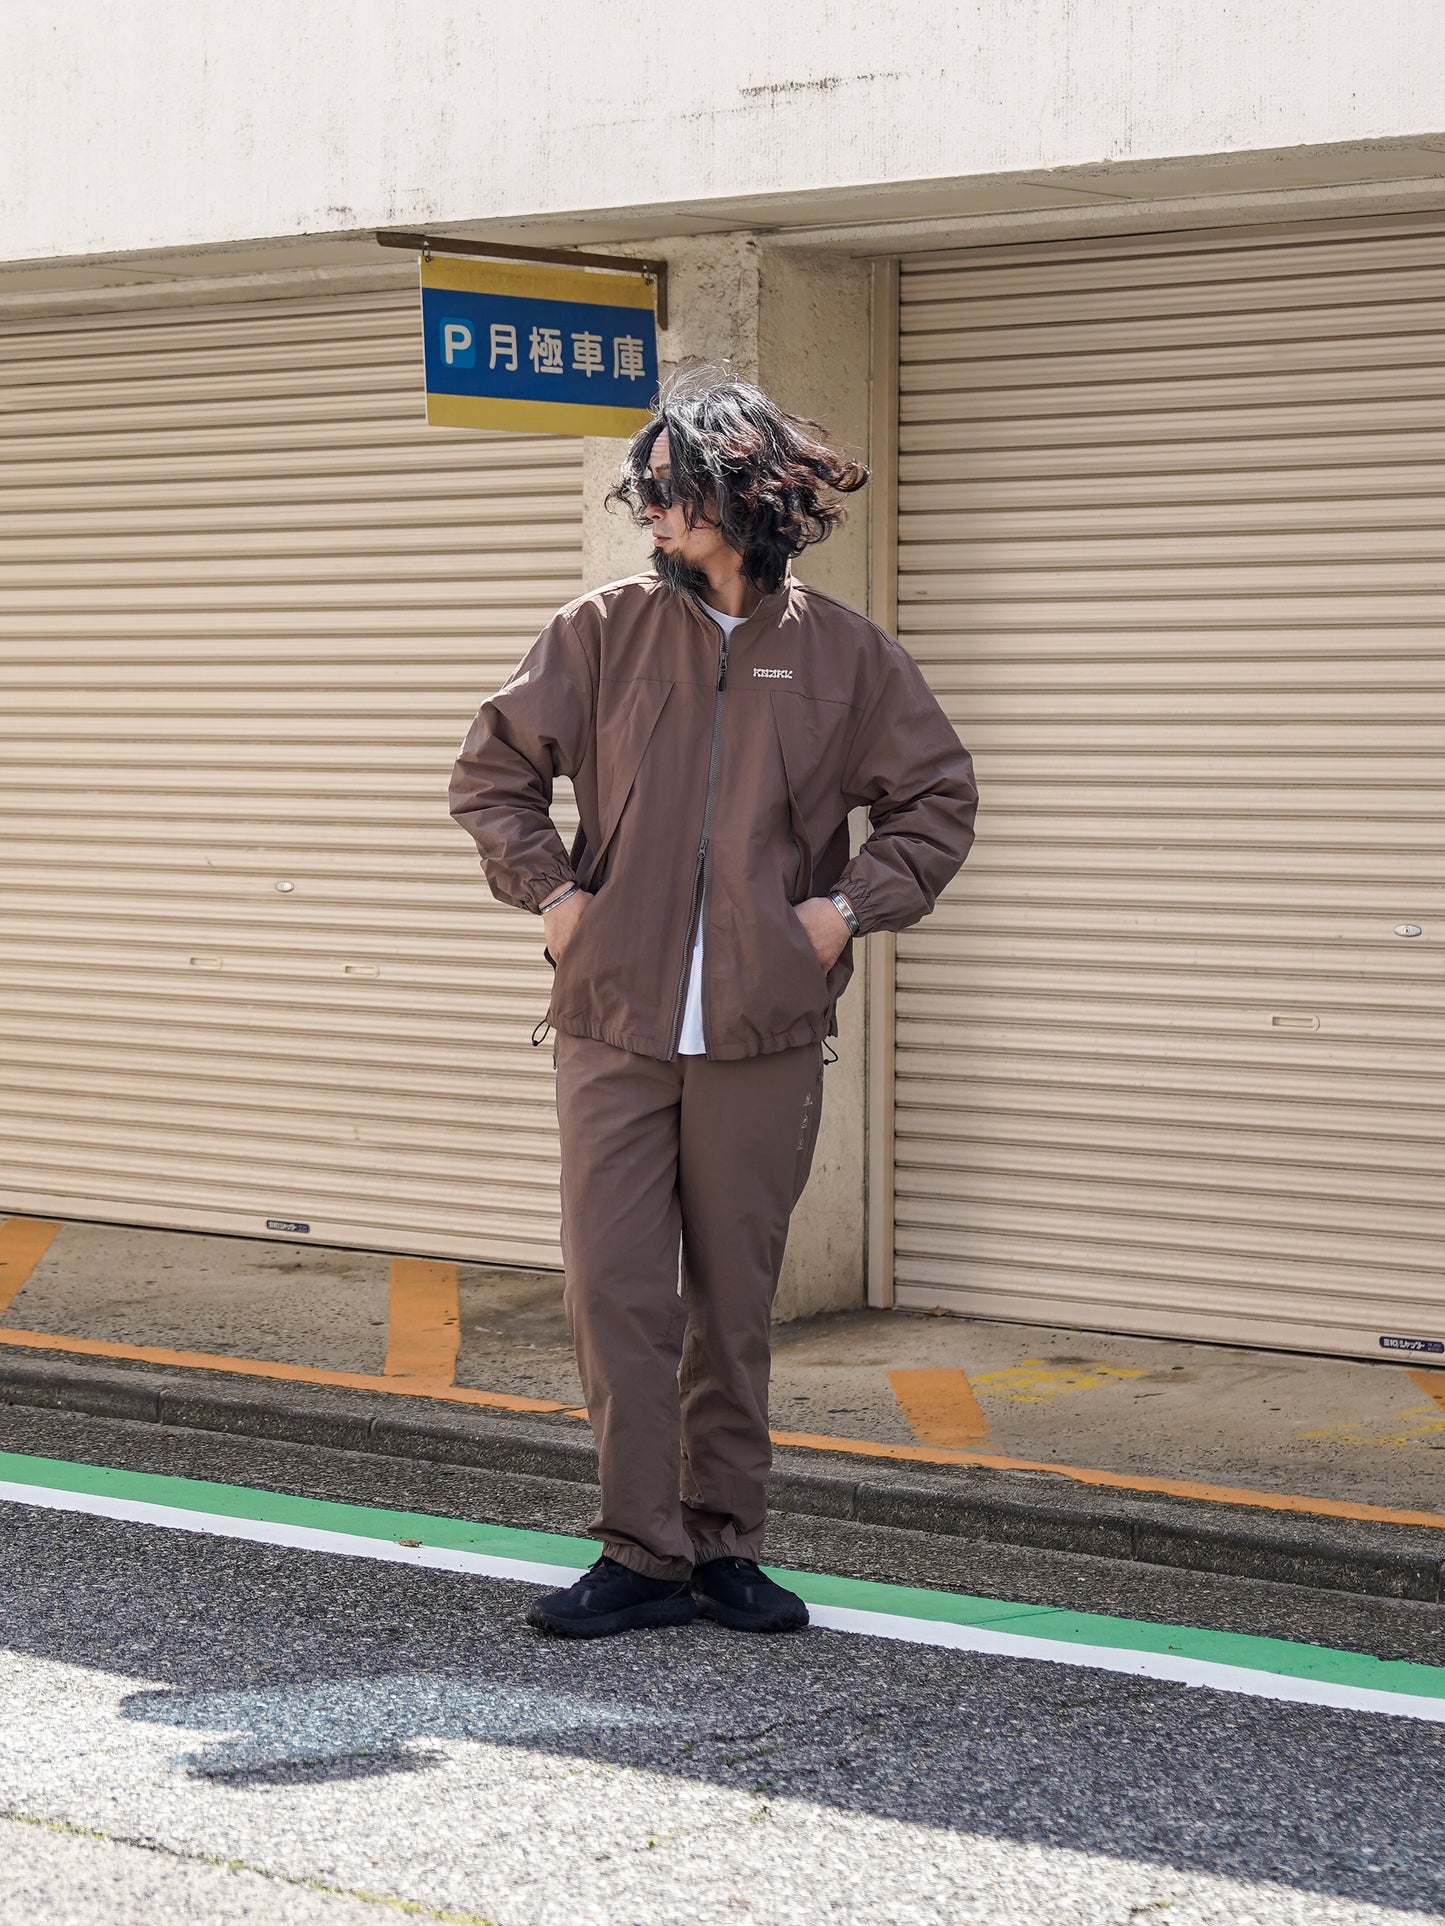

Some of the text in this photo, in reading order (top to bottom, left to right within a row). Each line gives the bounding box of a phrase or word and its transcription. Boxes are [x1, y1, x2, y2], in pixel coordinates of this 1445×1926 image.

[444, 323, 646, 382] P 月極車庫
